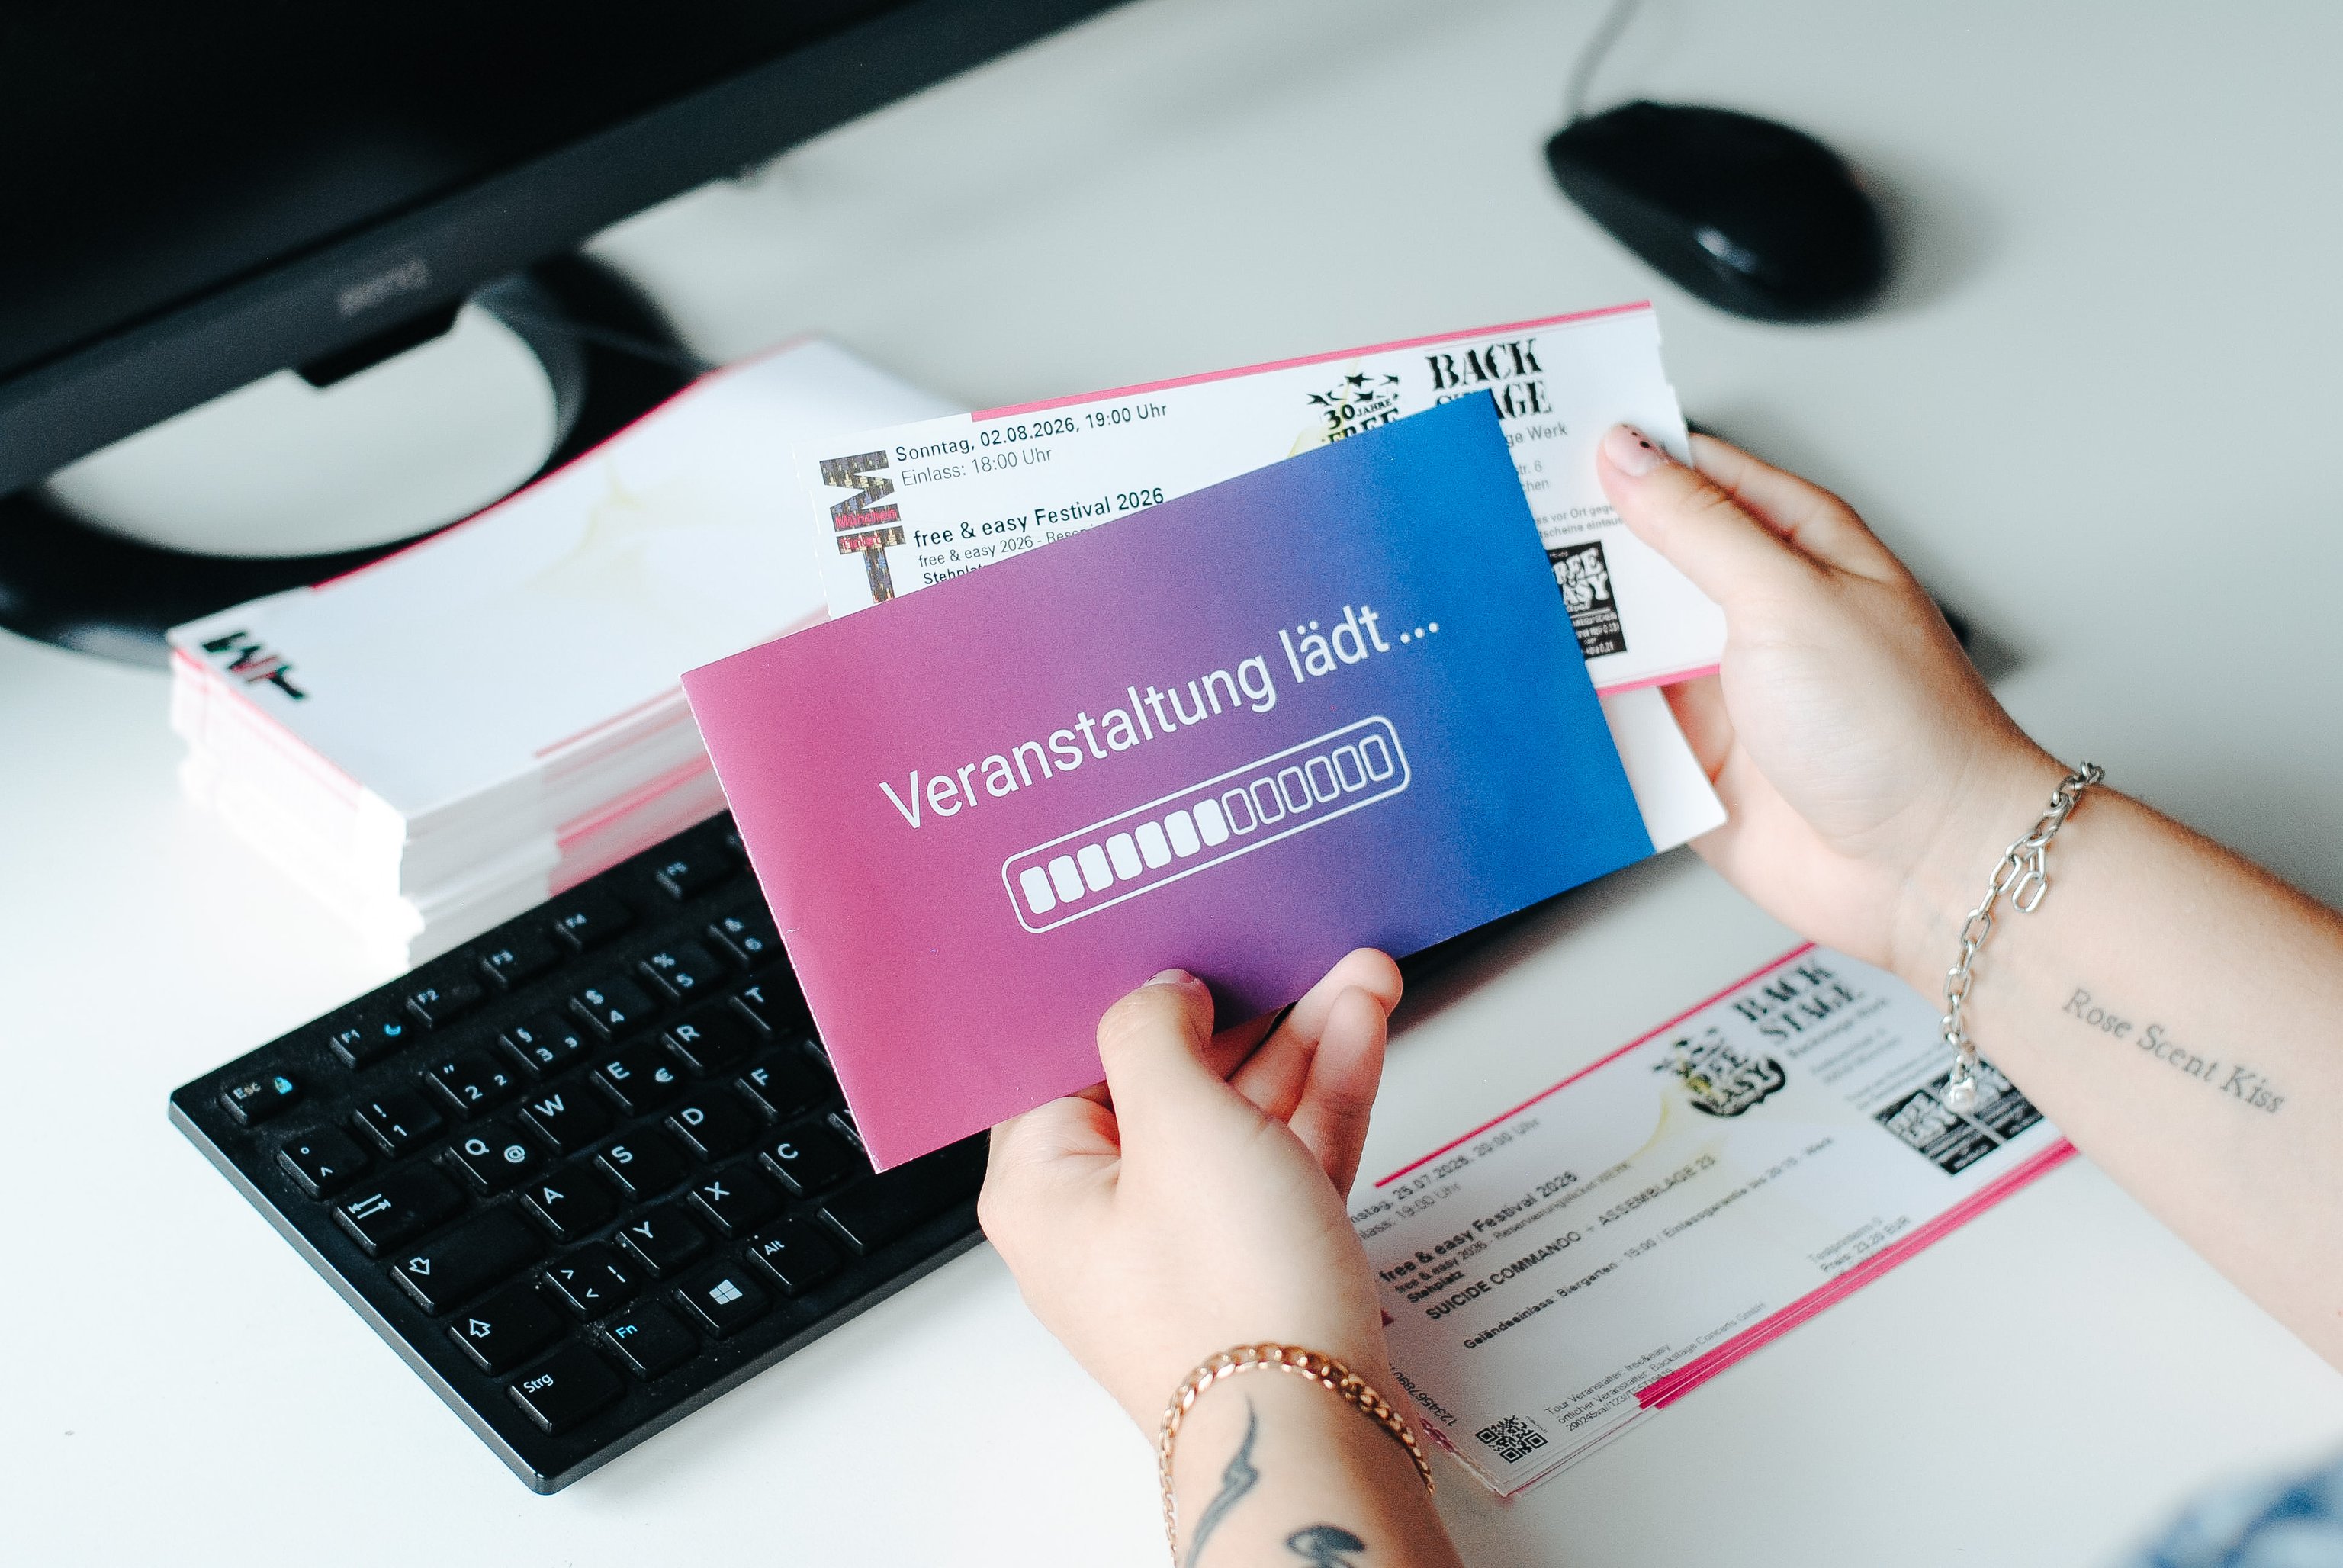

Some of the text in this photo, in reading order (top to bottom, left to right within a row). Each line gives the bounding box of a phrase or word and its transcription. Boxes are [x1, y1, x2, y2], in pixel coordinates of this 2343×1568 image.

[1425, 338, 1543, 391] BACK
[1326, 399, 1392, 429] 30 JAHRE
[896, 403, 1168, 461] Sonntag, 02.08.2026, 19:00 Uhr
[902, 447, 1052, 486] Einlass: 18:00 Uhr
[914, 529, 954, 548] free
[959, 522, 977, 539] &
[982, 516, 1028, 535] easy
[1033, 496, 1110, 525] Festival
[1117, 487, 1165, 512] 2026
[919, 554, 946, 567] free
[950, 549, 961, 562] &
[964, 544, 996, 557] easy
[1000, 535, 1034, 553] 2026
[879, 655, 1278, 830] Veranstaltung
[744, 986, 764, 1004] T
[676, 1024, 701, 1042] R
[2062, 988, 2285, 1113] Rose Scent Kiss
[607, 1062, 630, 1080] E
[751, 1069, 770, 1086] F
[233, 1081, 262, 1100] Esc
[464, 1086, 483, 1100] 2
[534, 1094, 565, 1117] W
[682, 1107, 705, 1126] D
[393, 1123, 407, 1137] 1
[464, 1139, 490, 1155] Q
[504, 1145, 525, 1163] @
[611, 1146, 633, 1164] S
[777, 1143, 799, 1160] C
[543, 1187, 564, 1204] A
[705, 1181, 730, 1200] X
[633, 1221, 654, 1239] Y
[1379, 1261, 1417, 1283] free
[1435, 1230, 1474, 1255] easy
[1472, 1194, 1538, 1232] Festival
[1537, 1171, 1579, 1199] 2026
[763, 1239, 785, 1256] Alt
[1425, 1280, 1492, 1320] SUICIDE
[1490, 1231, 1582, 1286] COMMANDO
[1557, 1261, 1618, 1298] Biergarten
[1407, 1269, 1465, 1303] Stehplatz
[615, 1322, 638, 1339] Fn
[1649, 1341, 1697, 1372] Backstage
[522, 1373, 554, 1395] Strg
[1546, 1401, 1570, 1415] Tour
